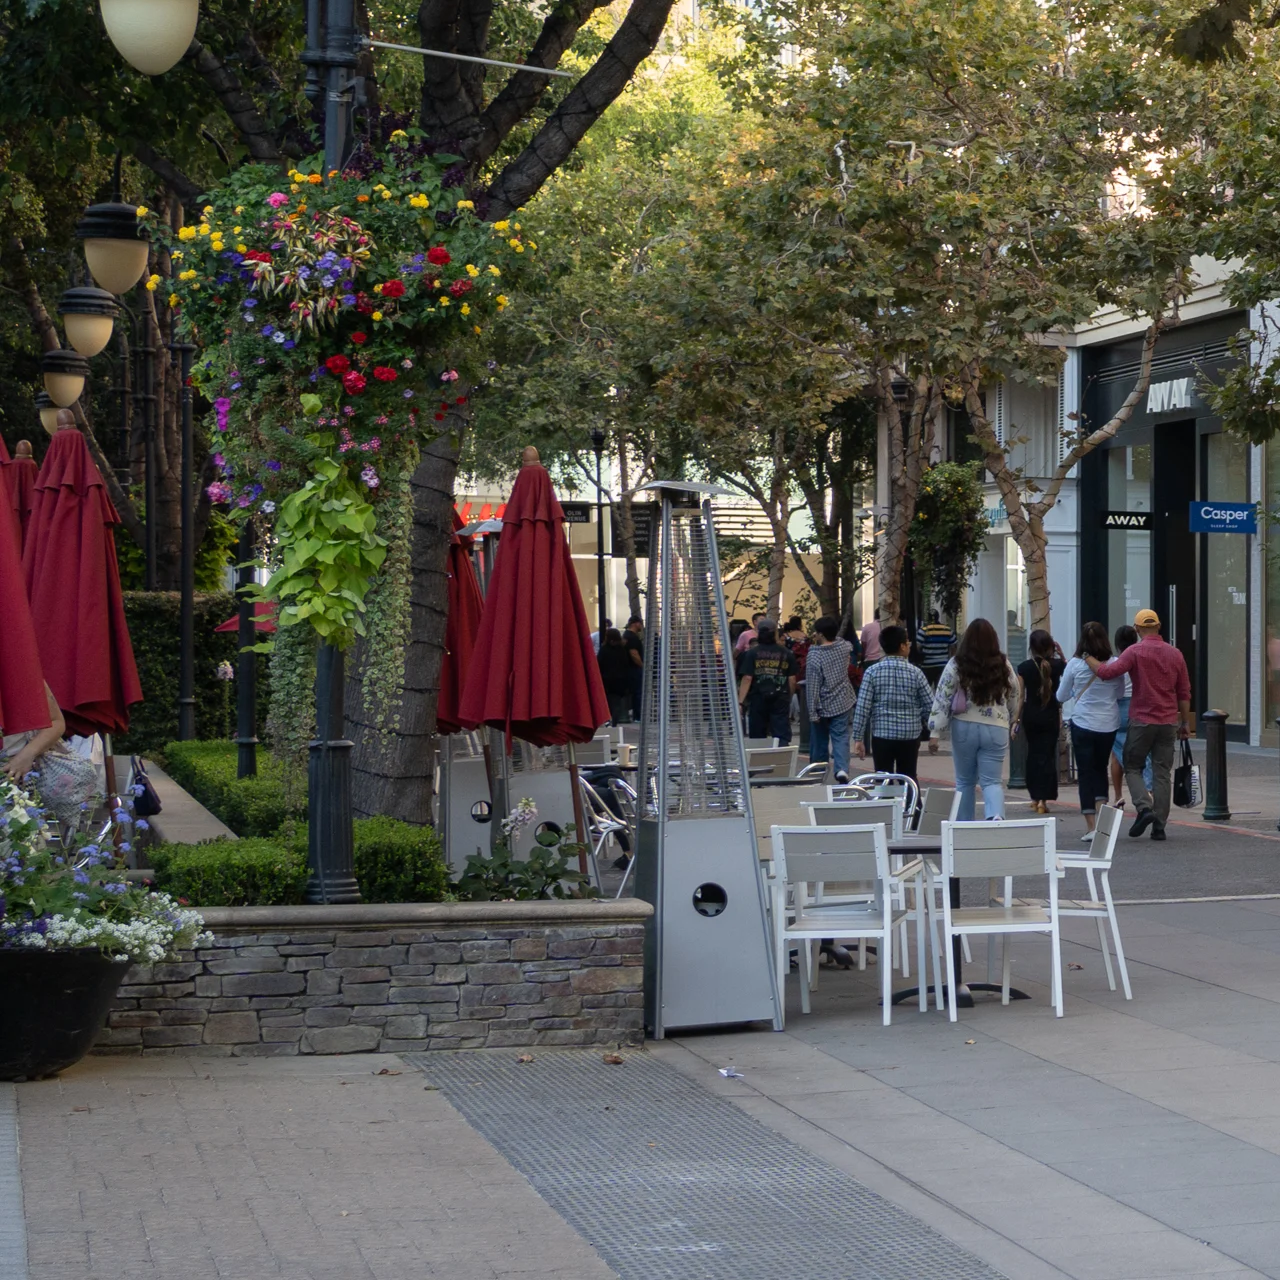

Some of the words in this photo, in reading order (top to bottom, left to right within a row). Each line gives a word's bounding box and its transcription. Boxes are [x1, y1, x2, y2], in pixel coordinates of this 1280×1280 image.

[1146, 377, 1191, 413] AWAY
[1105, 515, 1147, 526] AWAY
[1201, 506, 1249, 523] Casper
